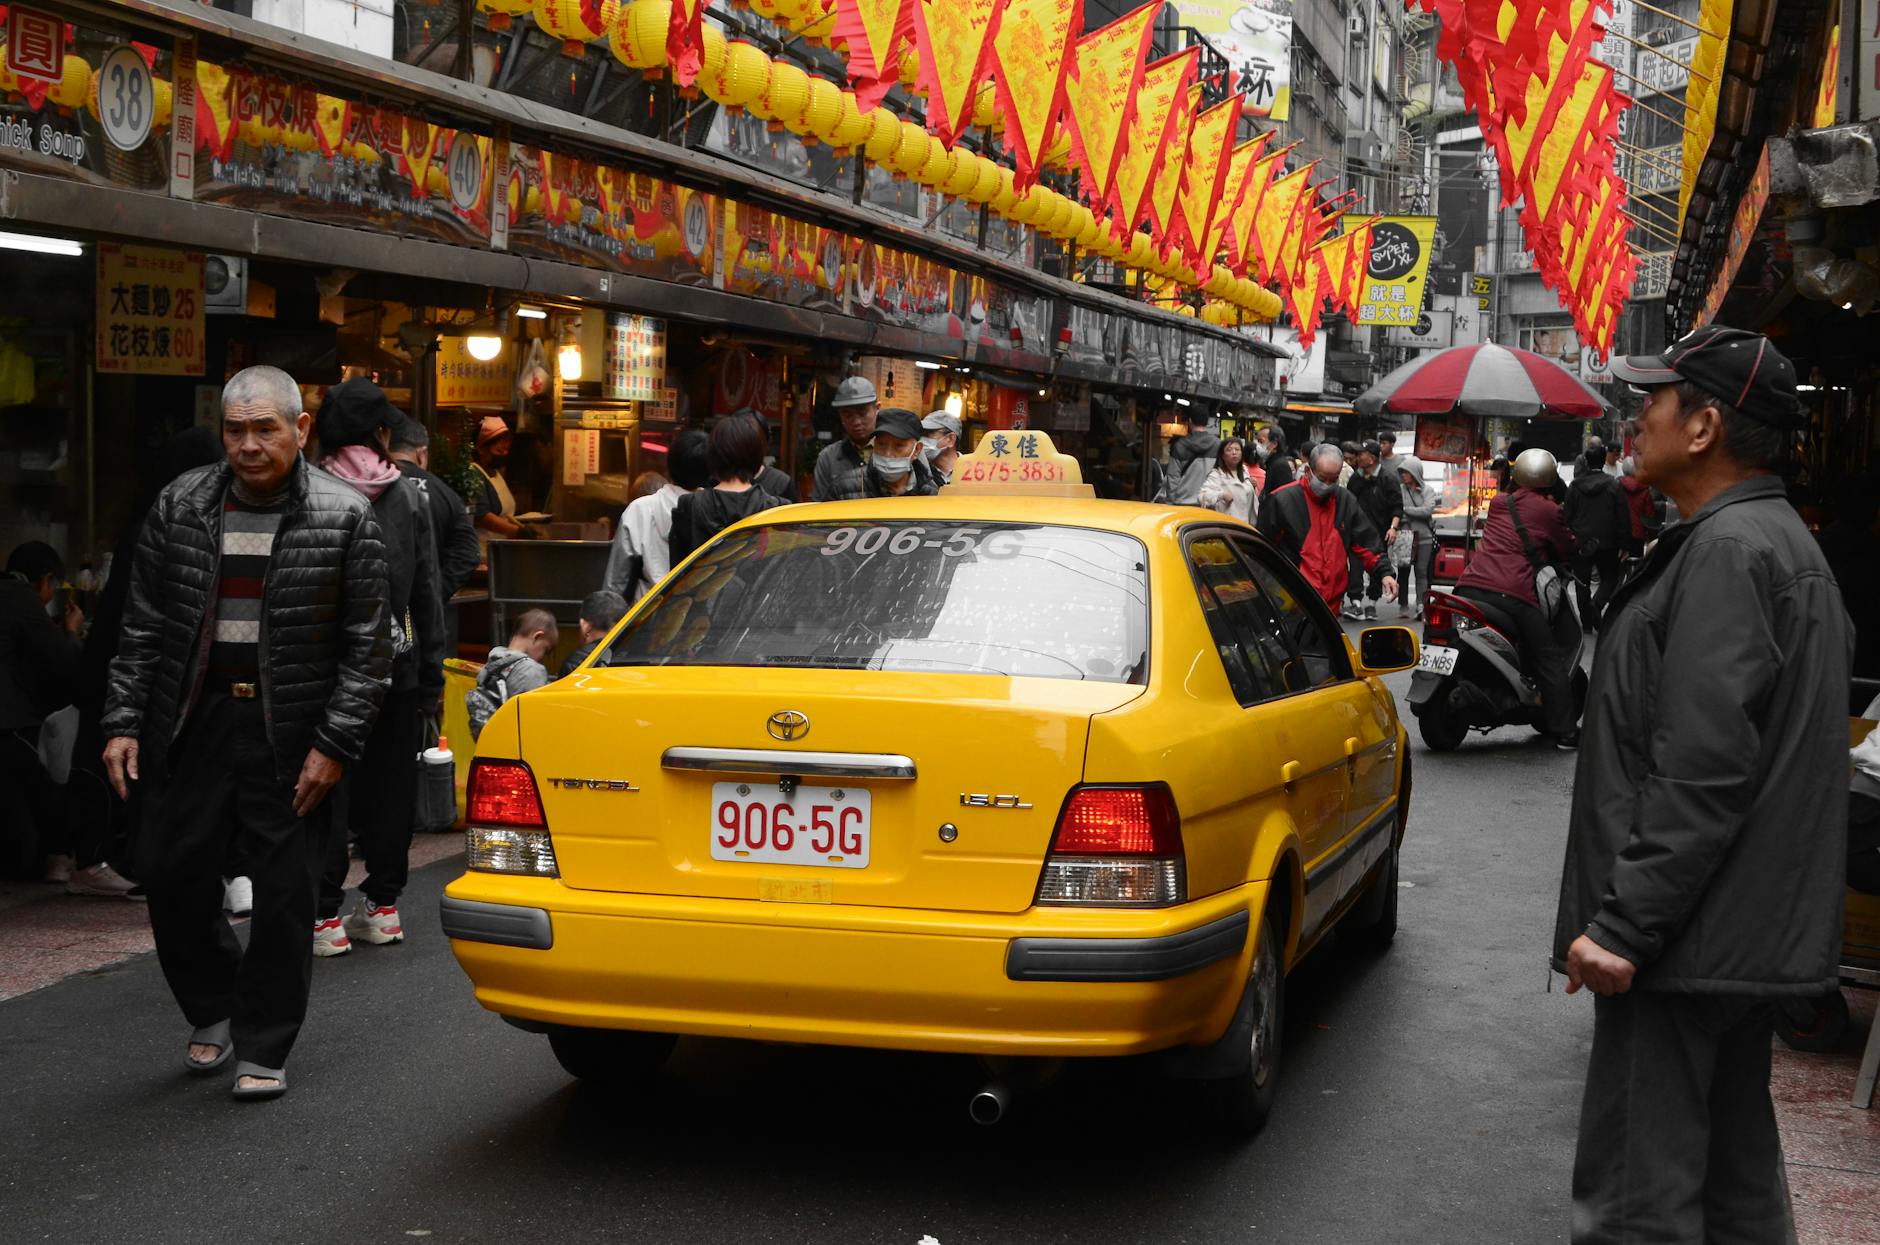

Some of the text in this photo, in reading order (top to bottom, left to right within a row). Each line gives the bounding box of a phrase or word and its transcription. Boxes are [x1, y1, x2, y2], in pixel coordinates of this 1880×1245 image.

[19, 14, 53, 72] 圓
[110, 63, 142, 131] 38
[454, 144, 474, 196] 40
[689, 208, 704, 246] 42
[1372, 242, 1410, 262] SUPER
[1398, 254, 1413, 267] XL
[111, 281, 195, 320] 大麵炒 25
[1370, 285, 1406, 302] 就是
[1360, 304, 1415, 322] 超大杯
[174, 327, 194, 358] 60
[989, 434, 1039, 458] 東佳
[961, 461, 1065, 482] 2675-3831
[820, 526, 1026, 560] 906-5G
[718, 800, 863, 856] 906-5G
